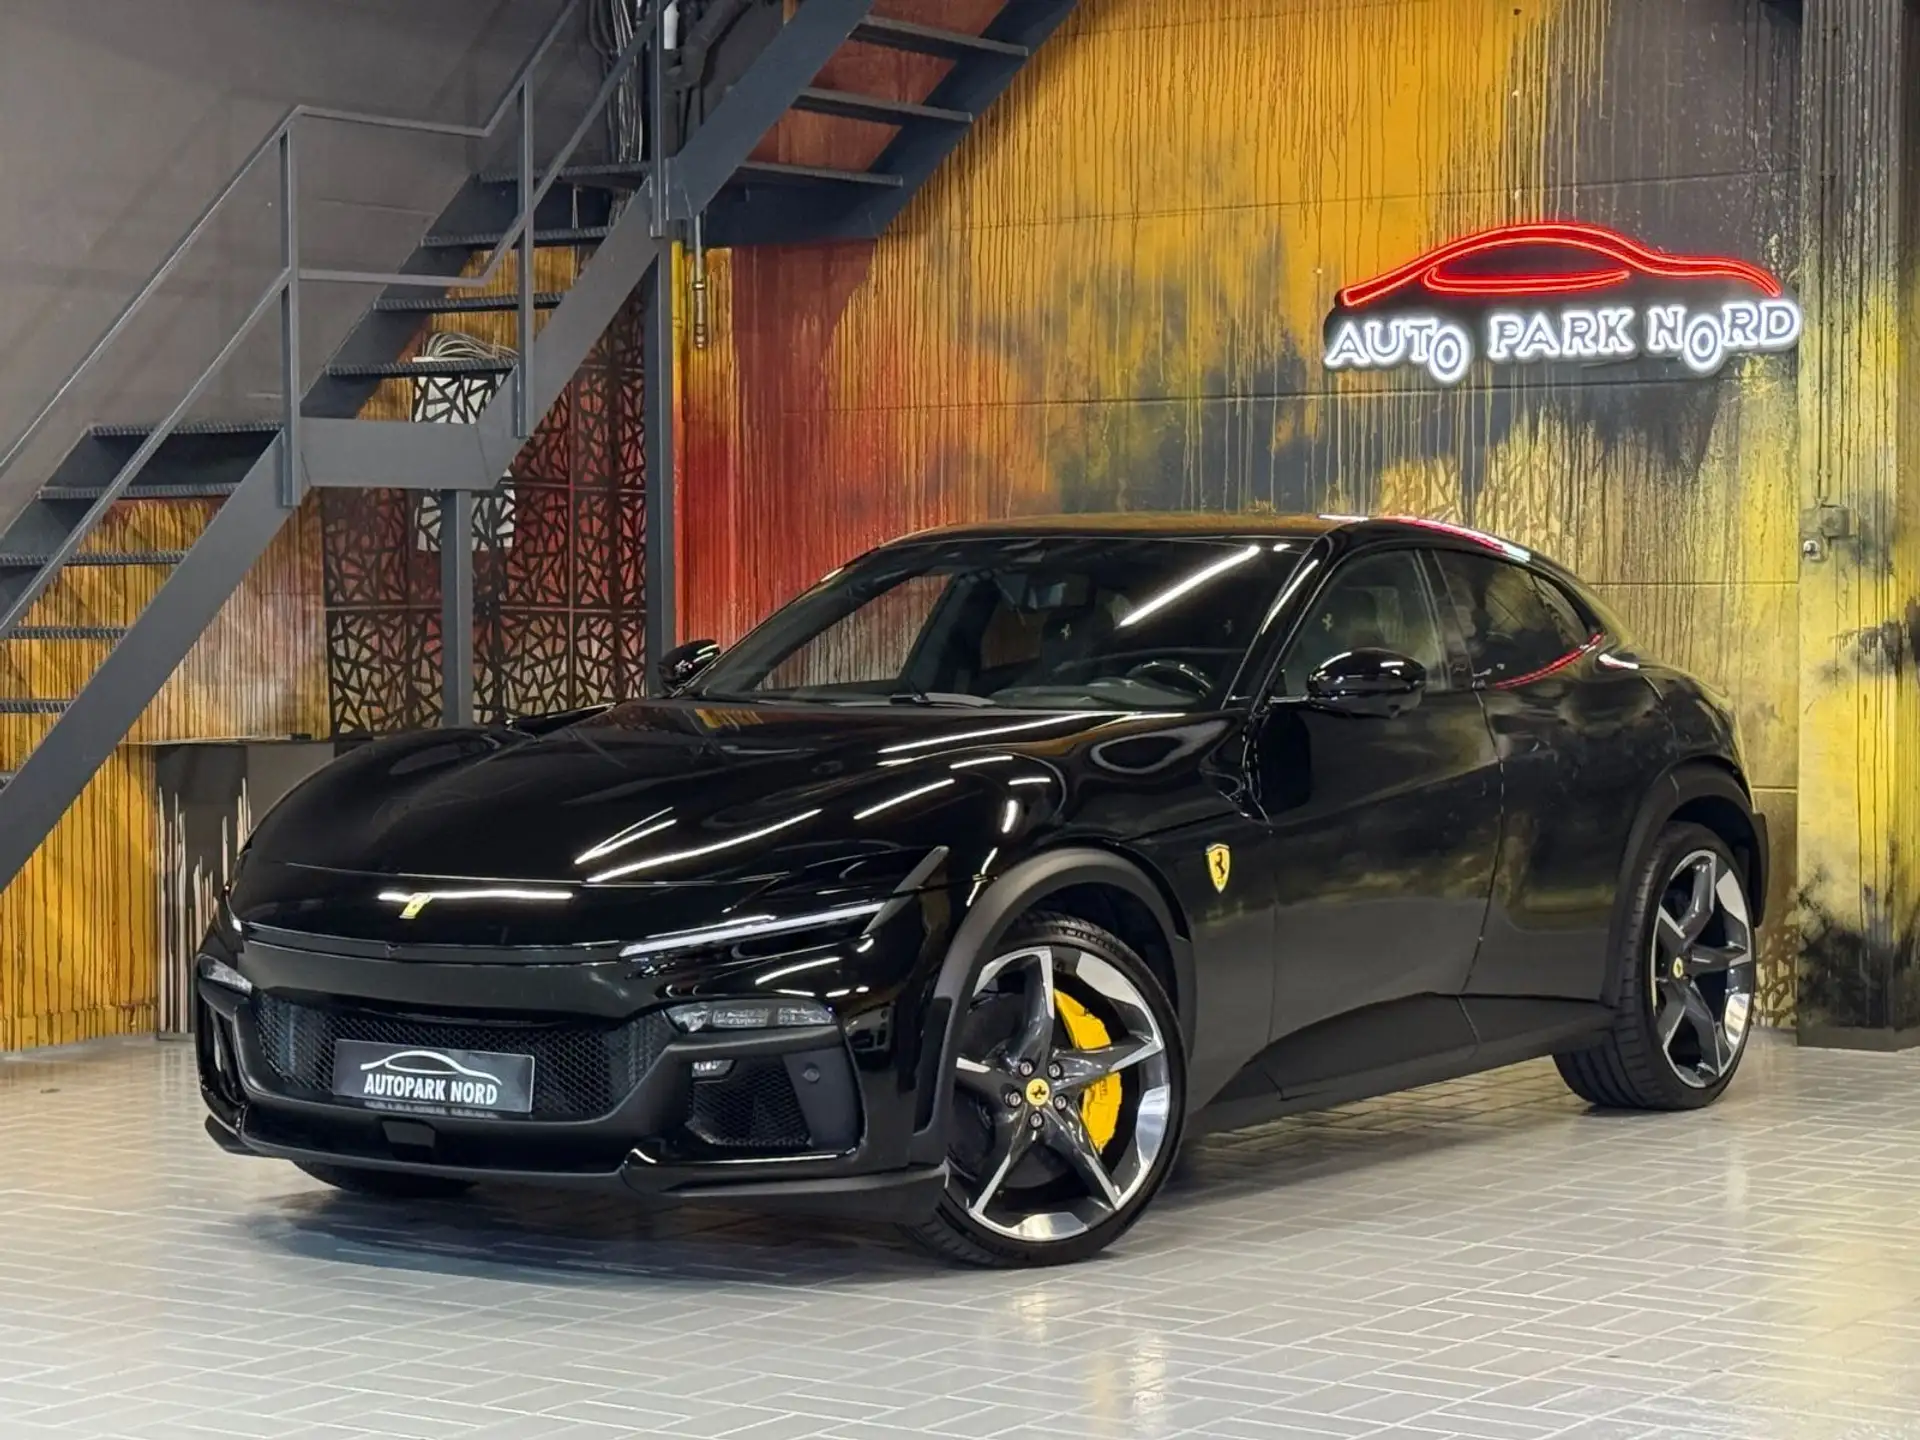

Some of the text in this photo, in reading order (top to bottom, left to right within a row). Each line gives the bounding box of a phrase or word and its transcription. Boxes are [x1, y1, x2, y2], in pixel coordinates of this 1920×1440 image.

[1328, 302, 1799, 381] AUTO PARK NORD
[364, 1074, 497, 1104] AUTOPARK NORD
